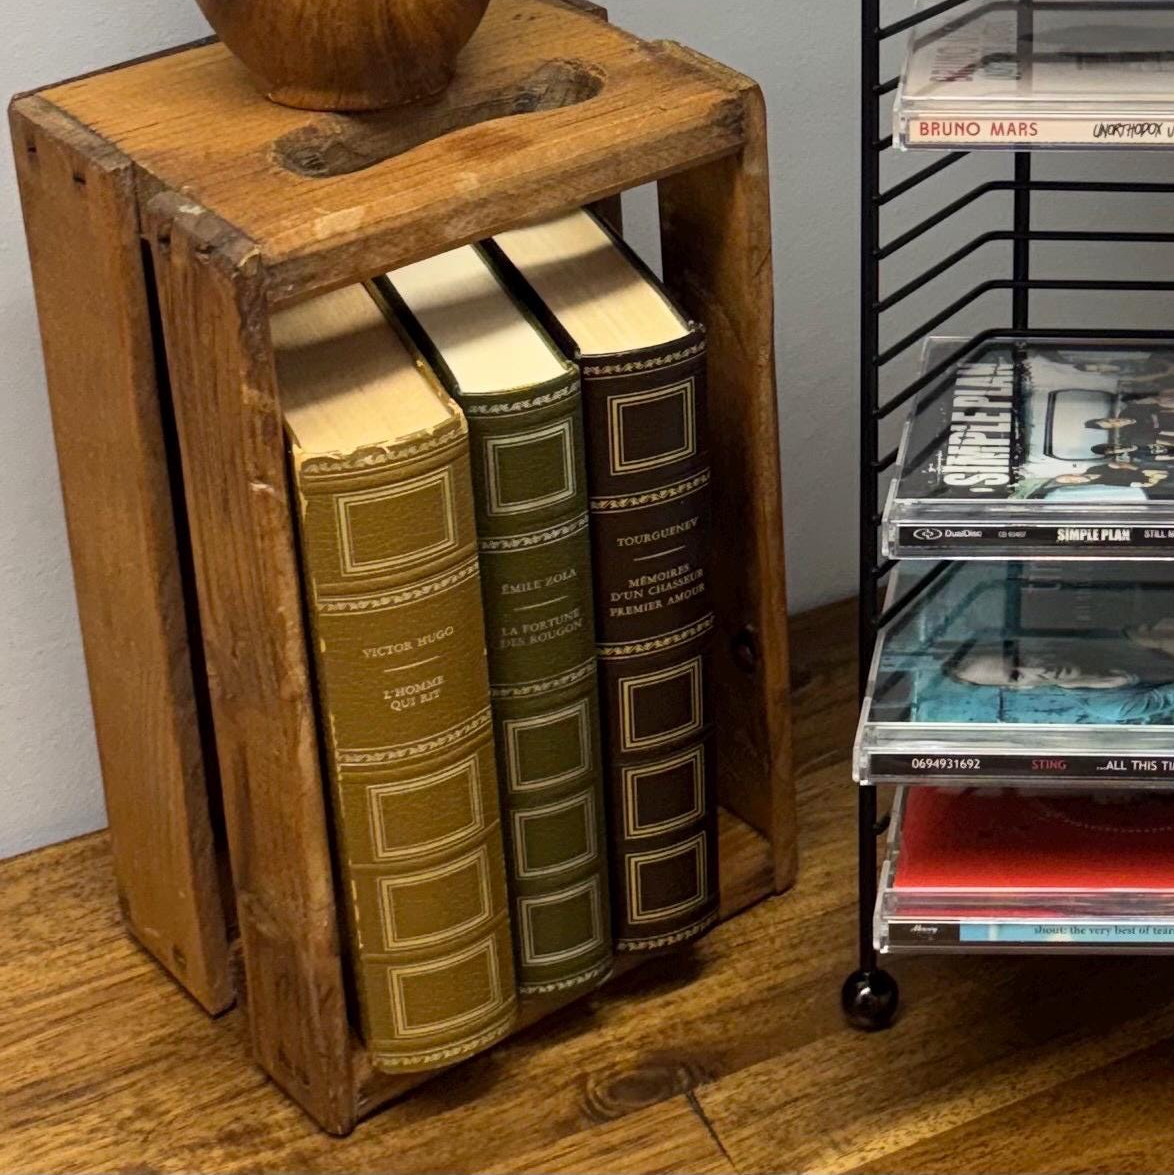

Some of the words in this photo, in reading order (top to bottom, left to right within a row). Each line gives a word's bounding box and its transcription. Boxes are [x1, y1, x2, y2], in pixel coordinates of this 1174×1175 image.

[919, 121, 982, 137] BRUNO
[990, 122, 1039, 137] MARS
[1092, 123, 1162, 139] UNORTHODOX
[952, 362, 1014, 409] PLAN
[942, 411, 1011, 487] SIMPLE
[944, 529, 983, 538] DualDisc
[1057, 527, 1099, 542] SIMPLE
[1101, 529, 1131, 541] PLAN
[1144, 529, 1167, 539] STILL
[544, 568, 577, 587] ZOLA
[610, 588, 644, 602] D'UN
[648, 568, 704, 596] CHASSEUR
[628, 562, 690, 588] MÉMOIRES
[609, 599, 663, 617] PREMIER
[666, 582, 705, 606] AMOUR
[502, 627, 518, 636] LA
[522, 608, 580, 634] FORTUNE
[529, 618, 584, 645] ROUGON
[362, 641, 414, 658] VICTOR
[417, 625, 454, 647] HUGO
[383, 675, 445, 700] L'HOMME
[390, 696, 416, 712] QUI
[420, 688, 441, 704] RIT
[911, 758, 981, 770] 0694931692
[1031, 759, 1067, 770] STING
[1131, 761, 1158, 771] THIS
[1070, 926, 1086, 935] the
[1090, 927, 1112, 937] very
[1114, 926, 1137, 936] best
[1138, 926, 1151, 935] of
